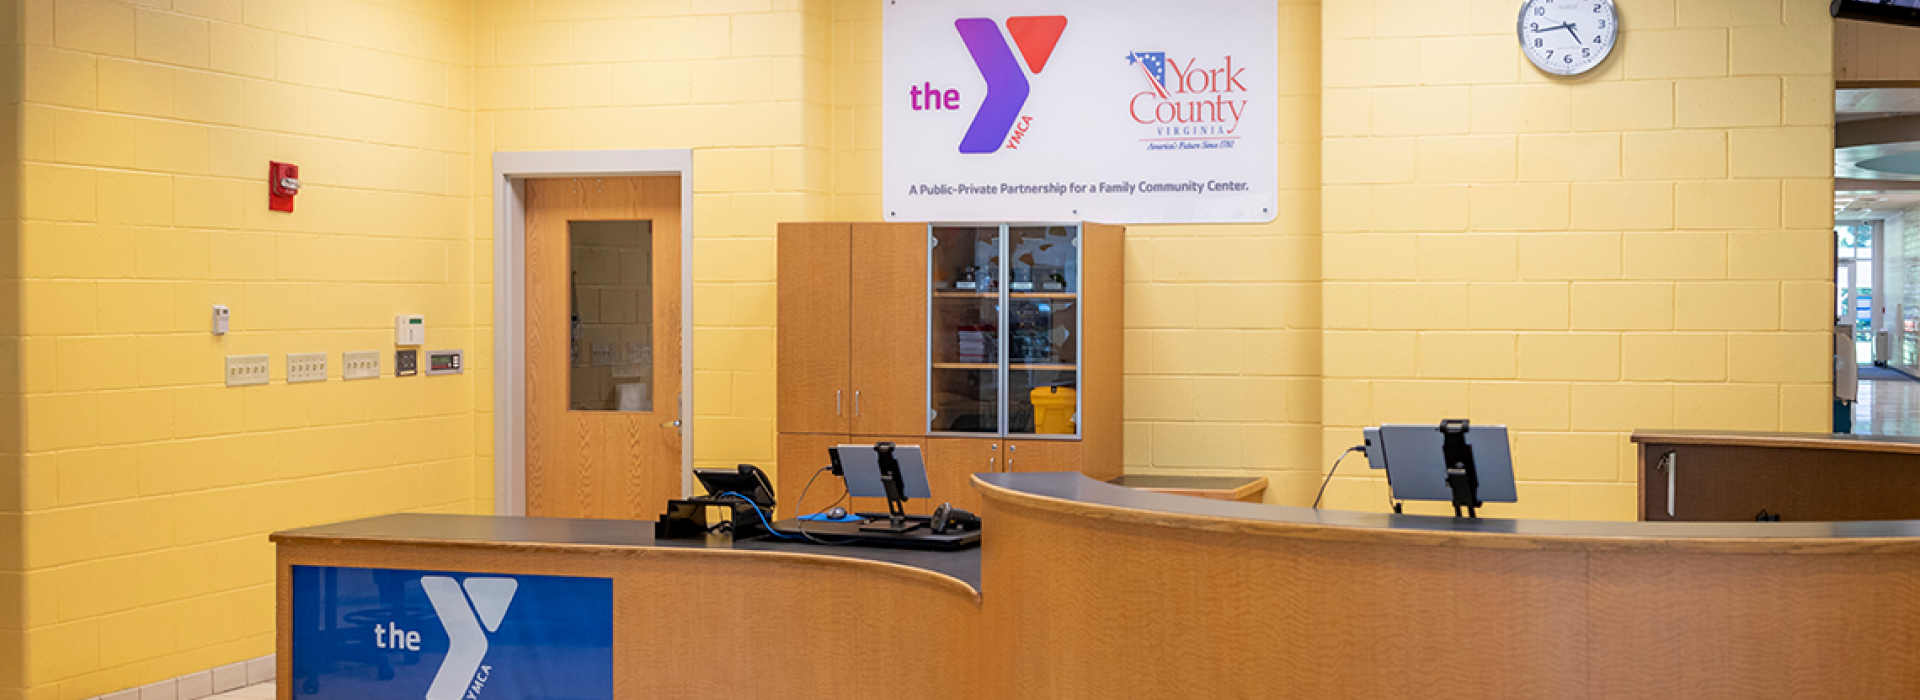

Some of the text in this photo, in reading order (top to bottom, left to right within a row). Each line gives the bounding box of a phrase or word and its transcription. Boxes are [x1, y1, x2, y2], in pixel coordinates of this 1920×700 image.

[1534, 6, 1545, 16] 10
[1593, 3, 1602, 13] 2
[1530, 22, 1539, 32] 9
[1598, 19, 1606, 29] 3
[1534, 37, 1543, 48] 8
[1593, 35, 1602, 44] 4
[1546, 49, 1554, 60] 7
[1581, 47, 1590, 58] 5
[1563, 54, 1573, 64] 6
[1166, 55, 1248, 94] York
[909, 82, 960, 111] the
[1129, 91, 1248, 134] County
[1006, 115, 1033, 150] YMCA
[1156, 126, 1225, 135] VIRGINIA
[908, 180, 1249, 196] A Public-Private Partnership for a Family Community Center.
[374, 621, 421, 652] the
[465, 665, 493, 700] YMCA
